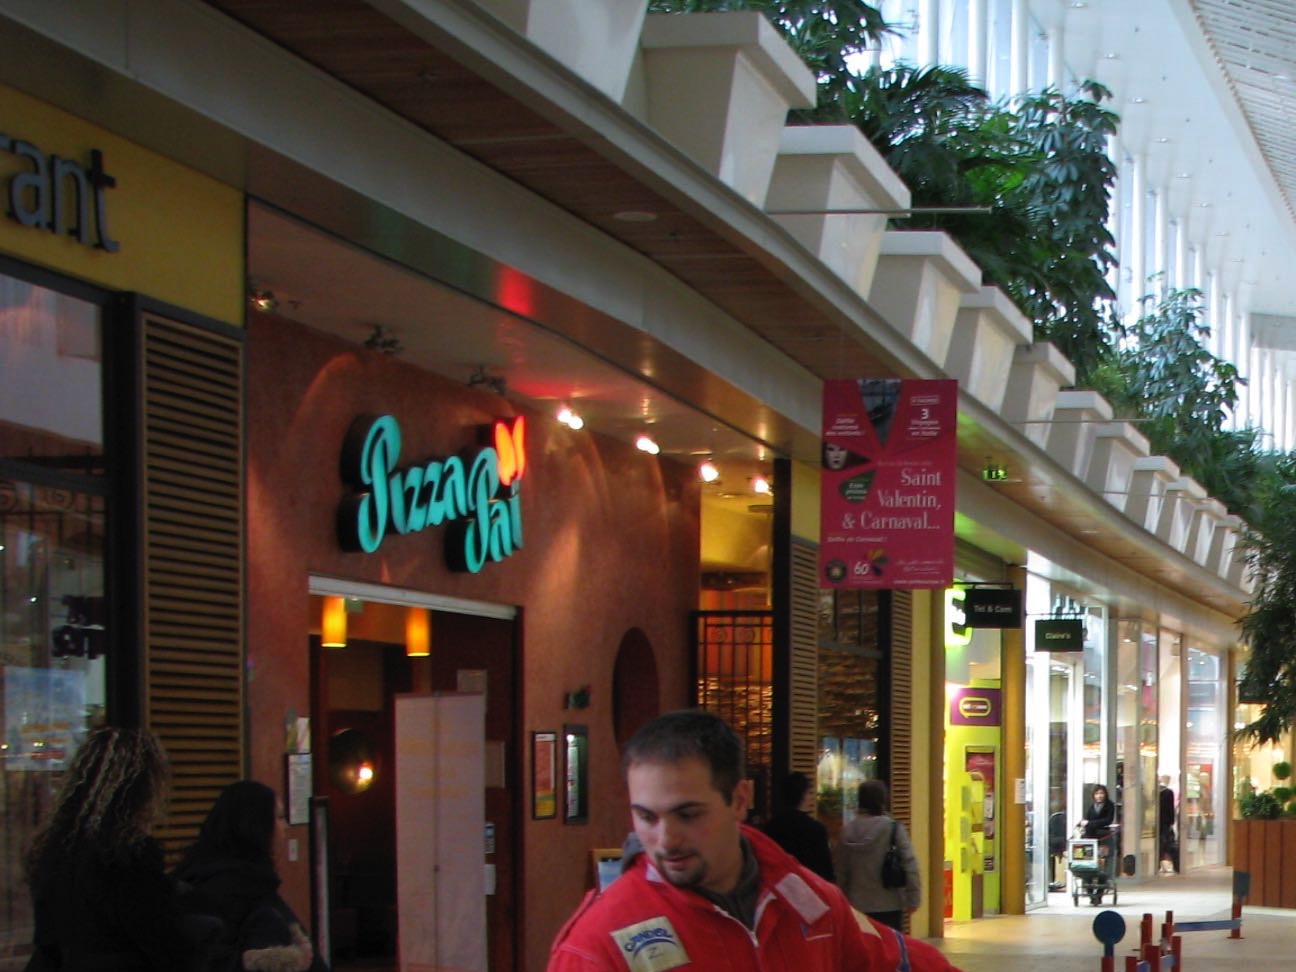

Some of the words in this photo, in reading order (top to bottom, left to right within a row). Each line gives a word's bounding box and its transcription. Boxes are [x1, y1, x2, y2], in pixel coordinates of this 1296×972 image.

[358, 415, 468, 553] Pizza
[900, 468, 942, 486] Saint
[877, 489, 942, 510] Valentin,
[842, 512, 856, 529] &
